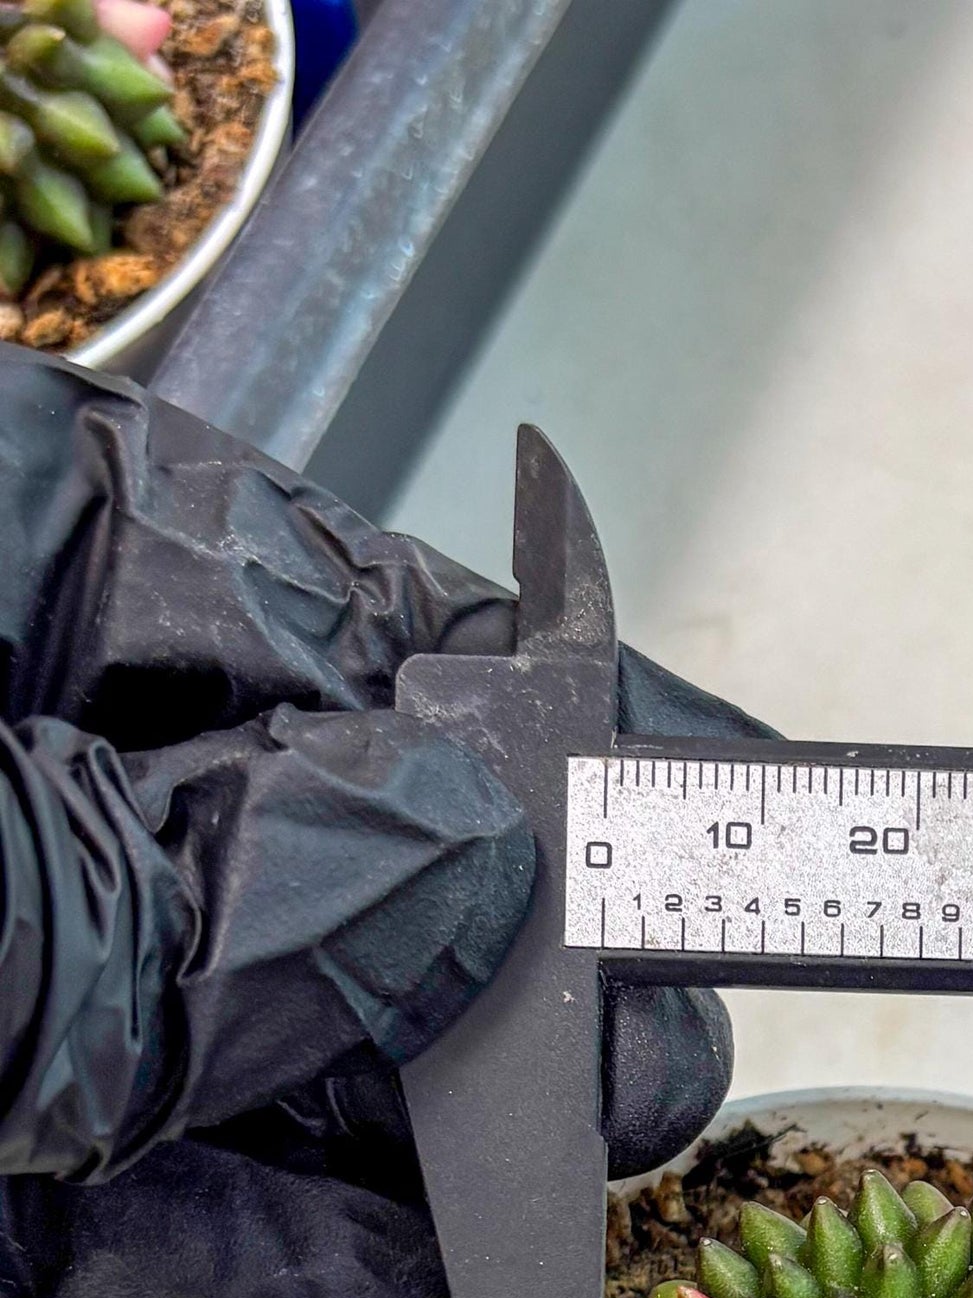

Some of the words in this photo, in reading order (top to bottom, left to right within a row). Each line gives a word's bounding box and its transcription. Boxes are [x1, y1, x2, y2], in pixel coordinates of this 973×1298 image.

[585, 841, 612, 869] 0
[706, 821, 751, 850] 10
[850, 826, 909, 854] 20
[632, 893, 643, 910] 1
[664, 894, 683, 912] 2
[705, 895, 722, 911] 3
[744, 897, 761, 914] 4
[784, 898, 801, 916] 5
[823, 900, 842, 917] 6
[866, 901, 882, 917] 7
[901, 902, 921, 919] 8
[942, 904, 960, 922] 9
